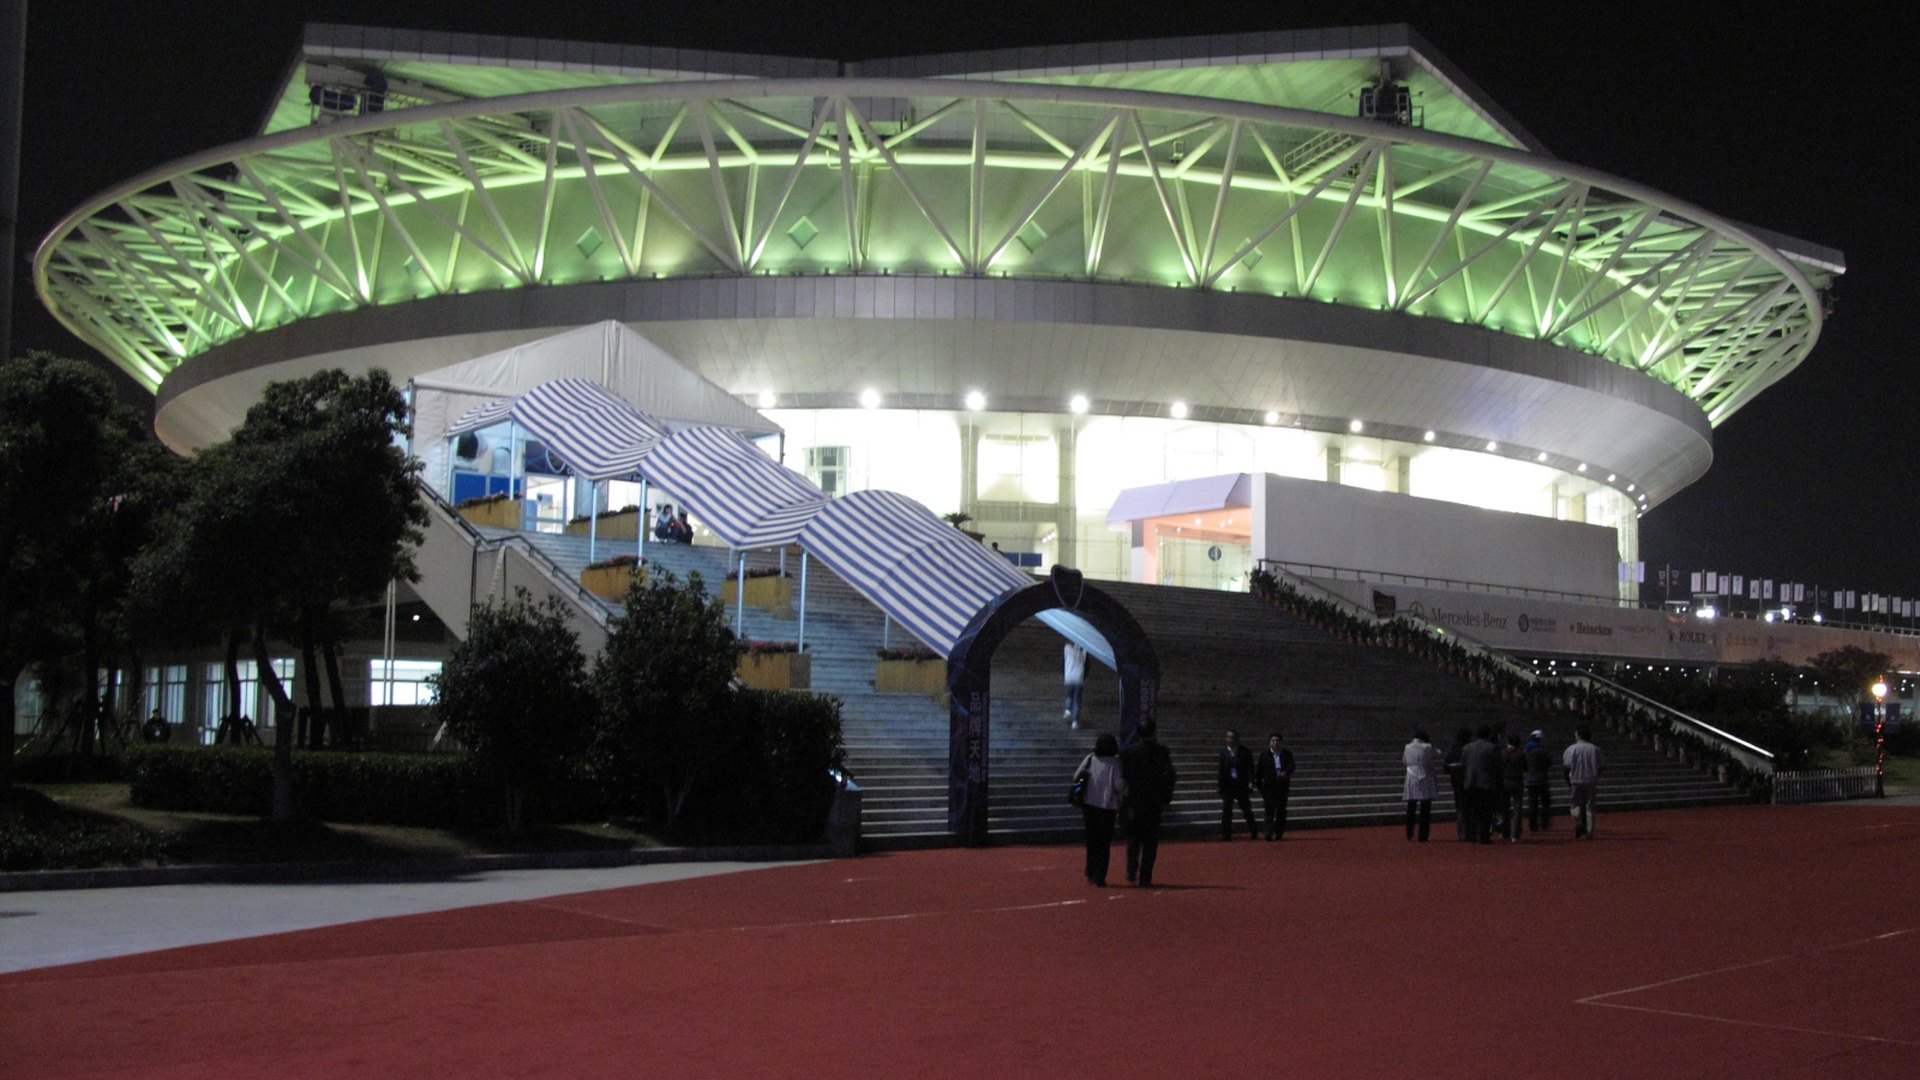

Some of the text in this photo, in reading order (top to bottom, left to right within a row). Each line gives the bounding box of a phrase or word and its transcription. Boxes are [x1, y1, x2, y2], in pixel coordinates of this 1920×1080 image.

[1431, 607, 1508, 629] Mercedes-Benz
[1577, 622, 1613, 636] Heineken
[1679, 630, 1707, 643] ROLEX
